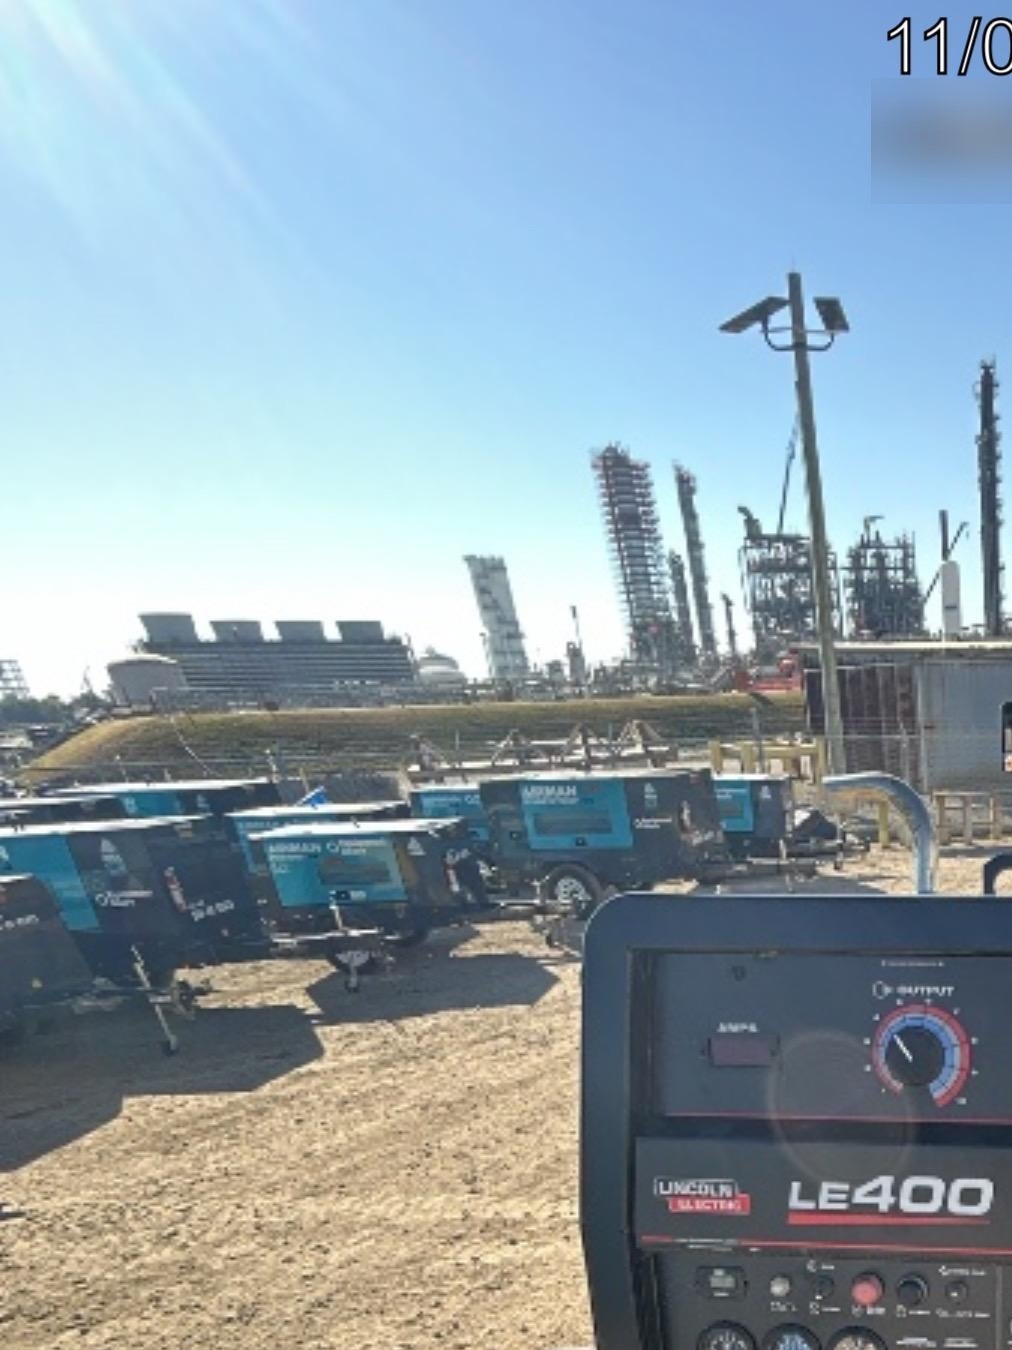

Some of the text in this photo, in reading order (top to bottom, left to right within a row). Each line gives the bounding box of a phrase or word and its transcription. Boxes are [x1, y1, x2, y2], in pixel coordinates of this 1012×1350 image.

[896, 985, 955, 997] OUTPUT
[659, 1181, 733, 1198] LINCOLN
[788, 1174, 995, 1216] LE400
